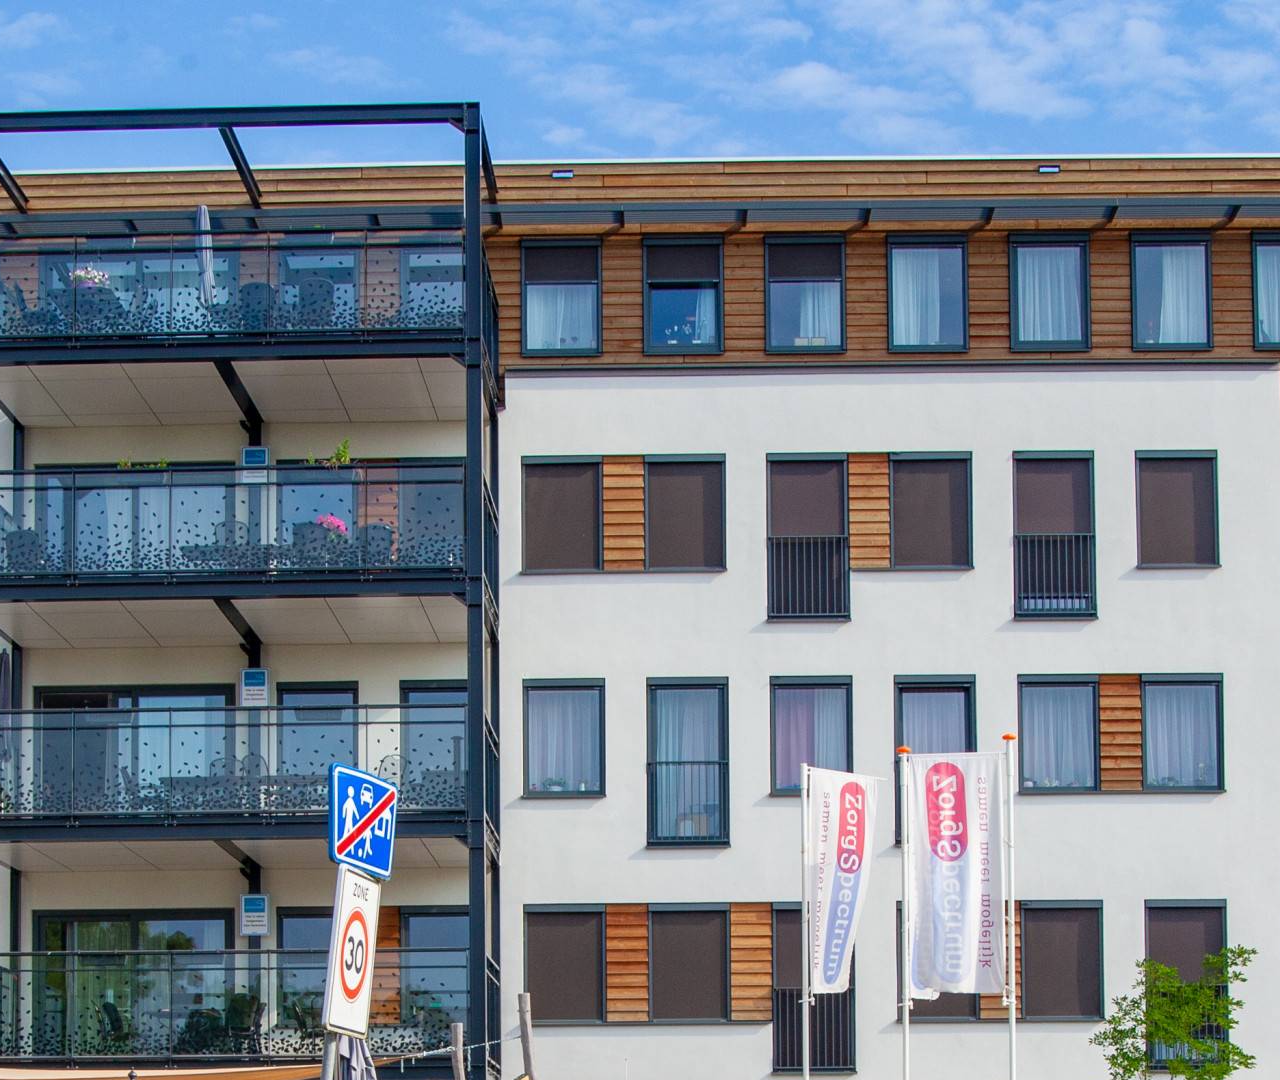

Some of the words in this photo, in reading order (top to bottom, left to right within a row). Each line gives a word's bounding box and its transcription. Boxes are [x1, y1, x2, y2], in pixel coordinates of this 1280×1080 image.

[819, 791, 831, 843] samen
[352, 882, 369, 902] ZONE
[826, 792, 863, 977] ZorgSpectrum
[344, 935, 365, 975] 30
